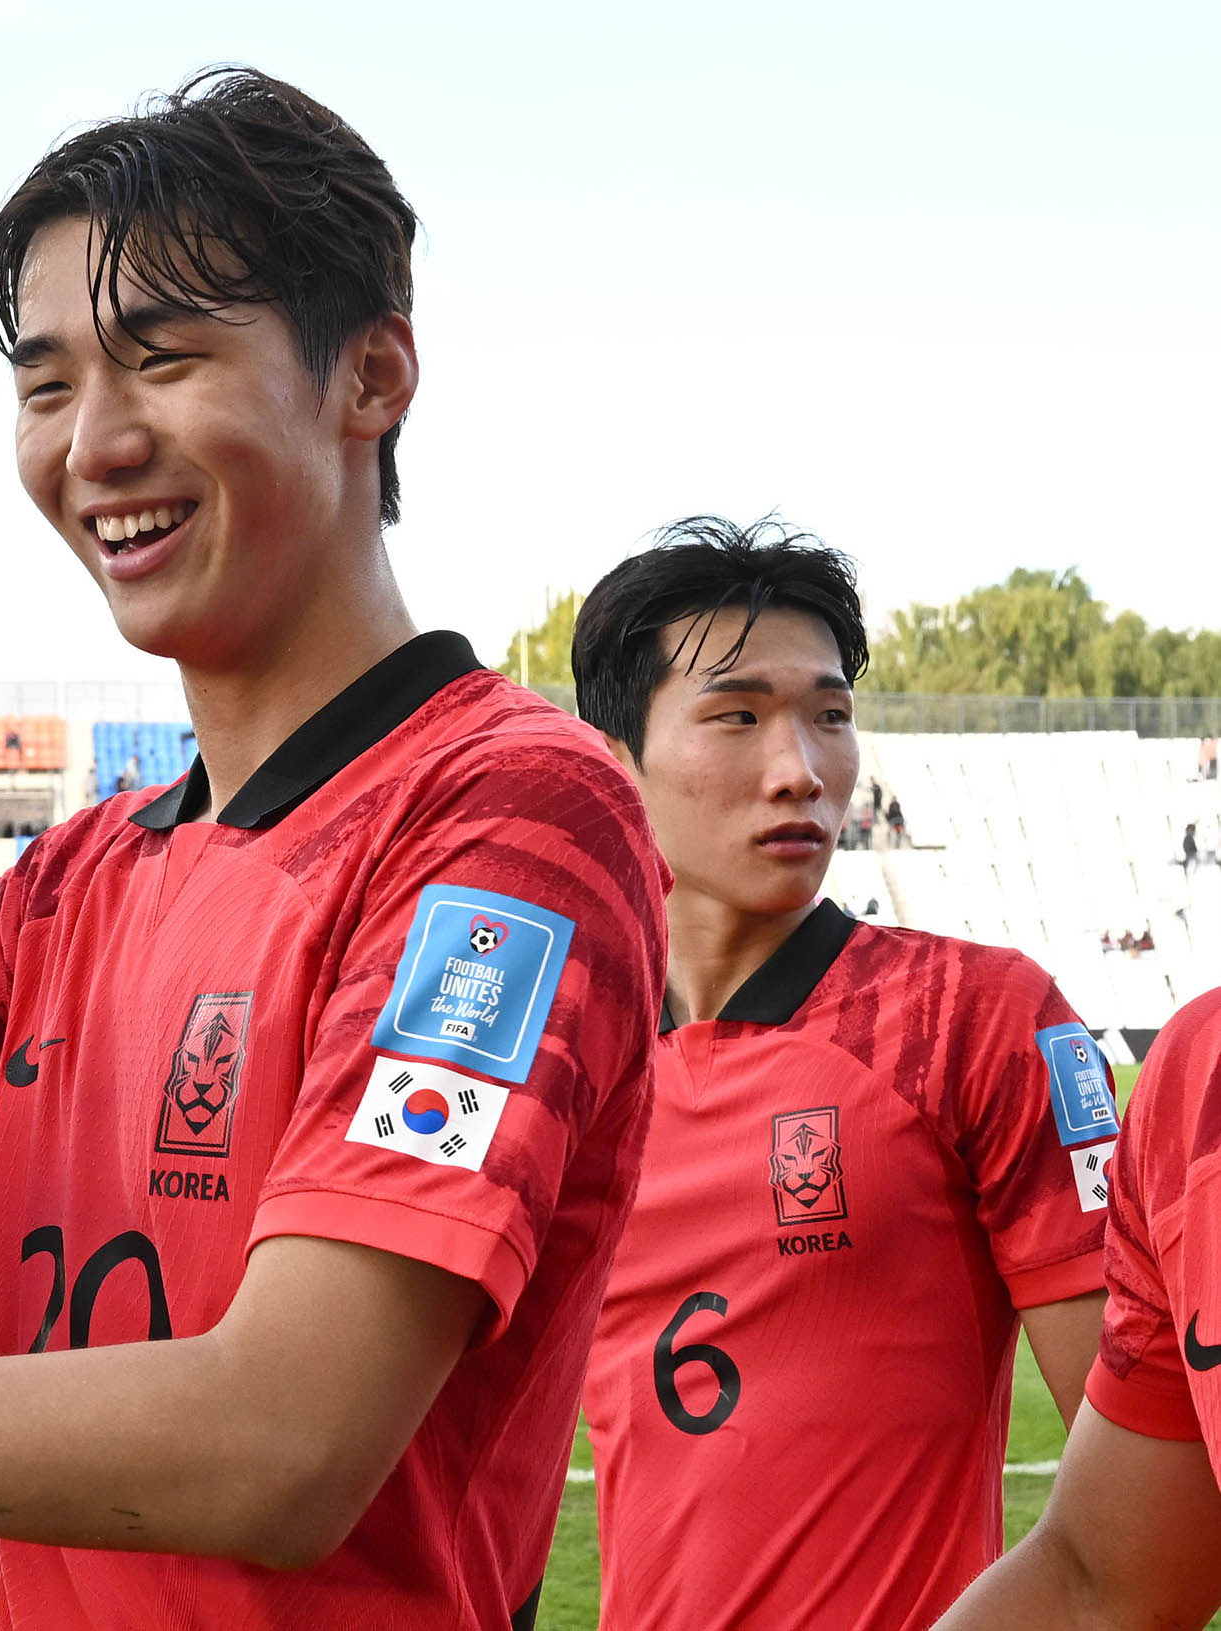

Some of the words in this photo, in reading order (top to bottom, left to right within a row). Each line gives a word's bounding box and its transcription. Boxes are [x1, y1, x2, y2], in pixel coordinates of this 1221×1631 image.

[444, 956, 505, 985] FOOTBALL
[439, 972, 502, 1006] UNITES
[431, 996, 454, 1013] the
[454, 999, 500, 1028] World
[445, 1023, 469, 1036] FIFA
[1077, 1079, 1103, 1096] UNITE
[1094, 1109, 1108, 1118] FIFA
[148, 1169, 230, 1201] KOREA
[778, 1231, 853, 1256] KOREA
[654, 1291, 741, 1435] 6
